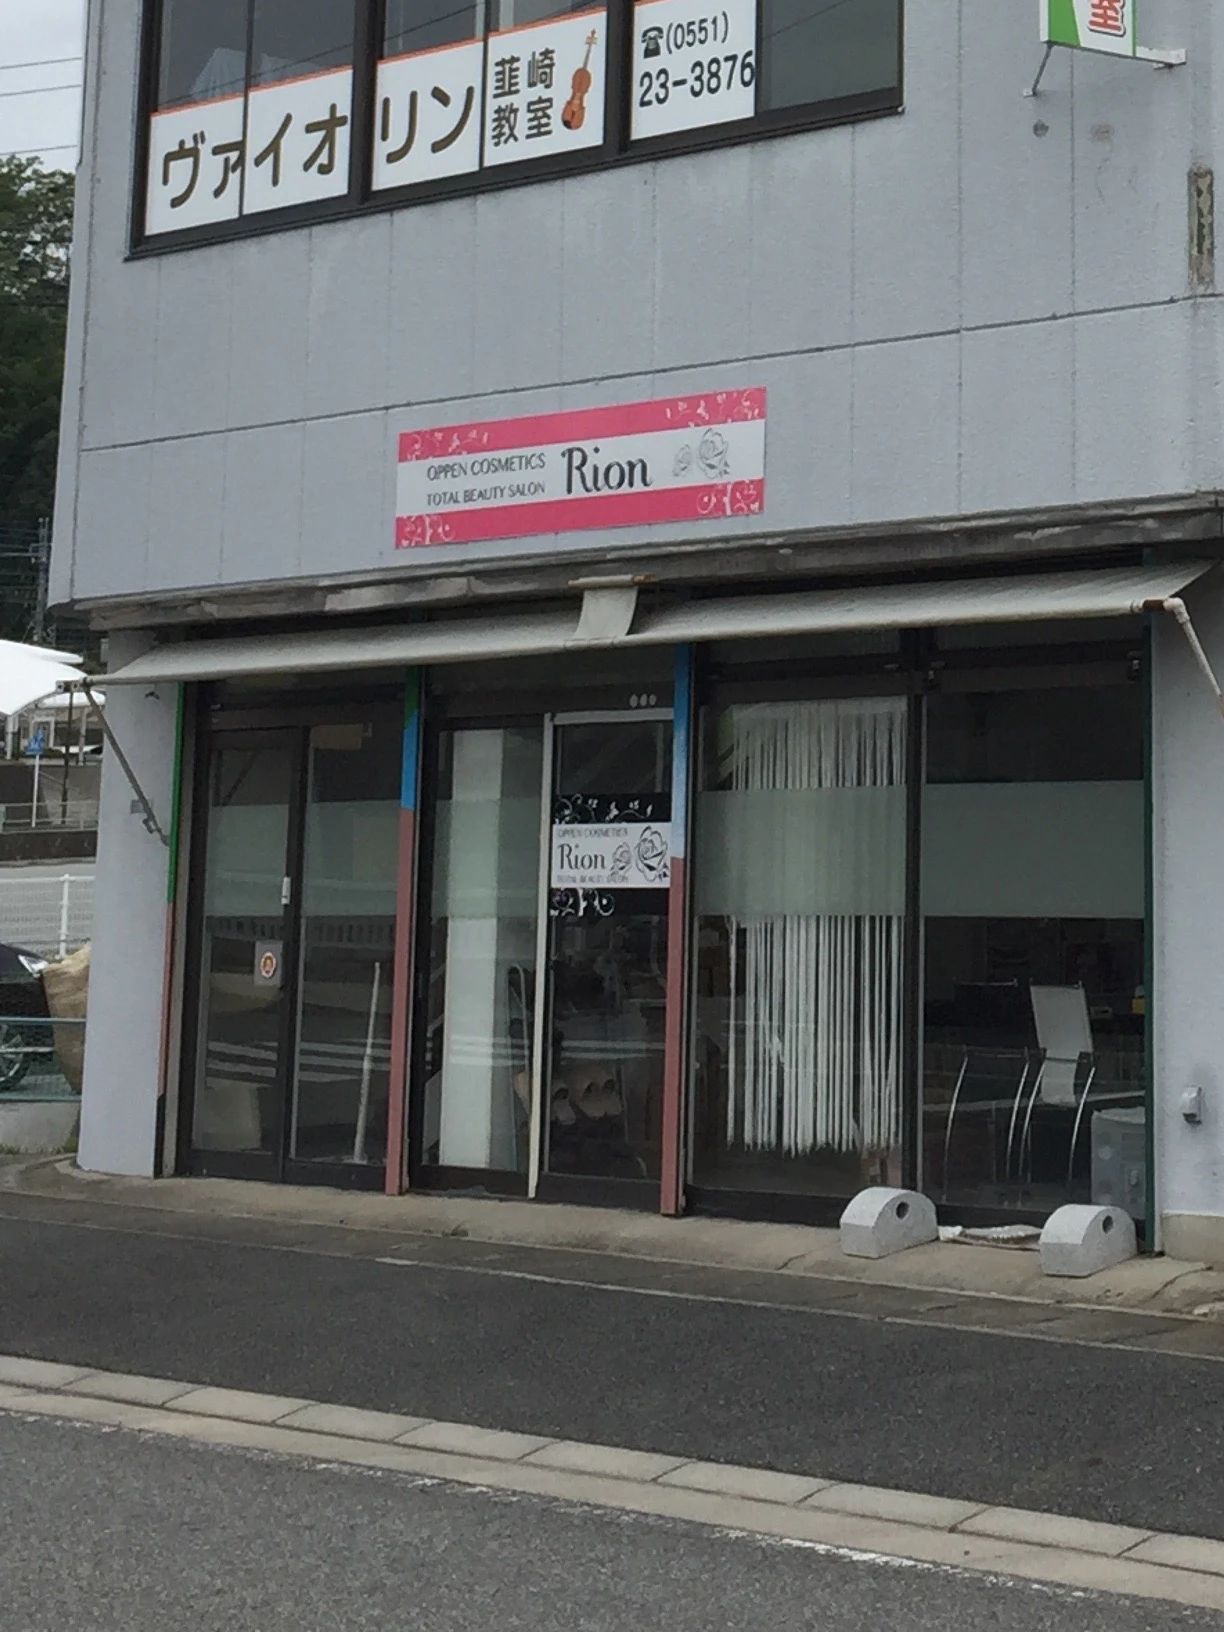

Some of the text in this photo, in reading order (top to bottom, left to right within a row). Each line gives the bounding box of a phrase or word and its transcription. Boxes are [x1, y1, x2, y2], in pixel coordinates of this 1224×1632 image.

[667, 11, 728, 54] (0551)
[492, 47, 556, 99] 韮崎
[639, 50, 756, 107] 23-3876
[491, 95, 554, 147] 教室
[470, 452, 546, 476] COSMETICS
[561, 445, 651, 495] Rion
[427, 480, 546, 506] TOTAL BEAUTY SALON
[557, 842, 606, 870] Rion
